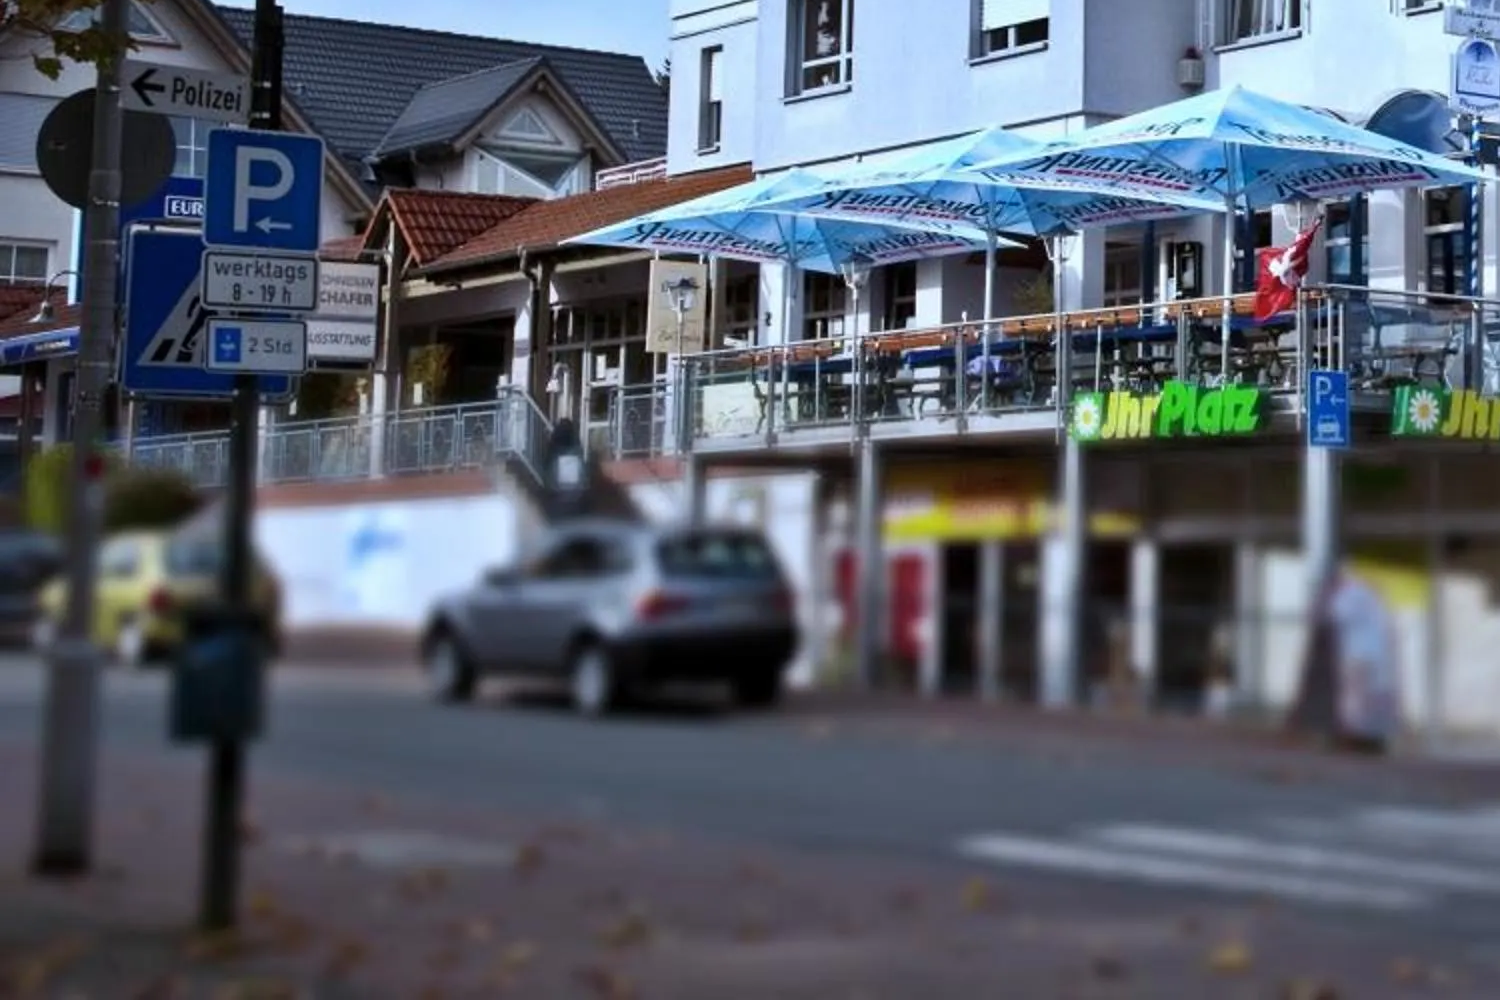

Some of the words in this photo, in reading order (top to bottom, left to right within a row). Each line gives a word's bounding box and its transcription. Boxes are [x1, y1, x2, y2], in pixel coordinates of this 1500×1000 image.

[171, 77, 242, 112] Polizei
[233, 145, 295, 233] P
[214, 261, 308, 284] werktags
[233, 283, 242, 301] 8
[260, 285, 276, 303] 19
[283, 286, 292, 305] h
[248, 336, 258, 353] 2
[1315, 376, 1332, 405] P
